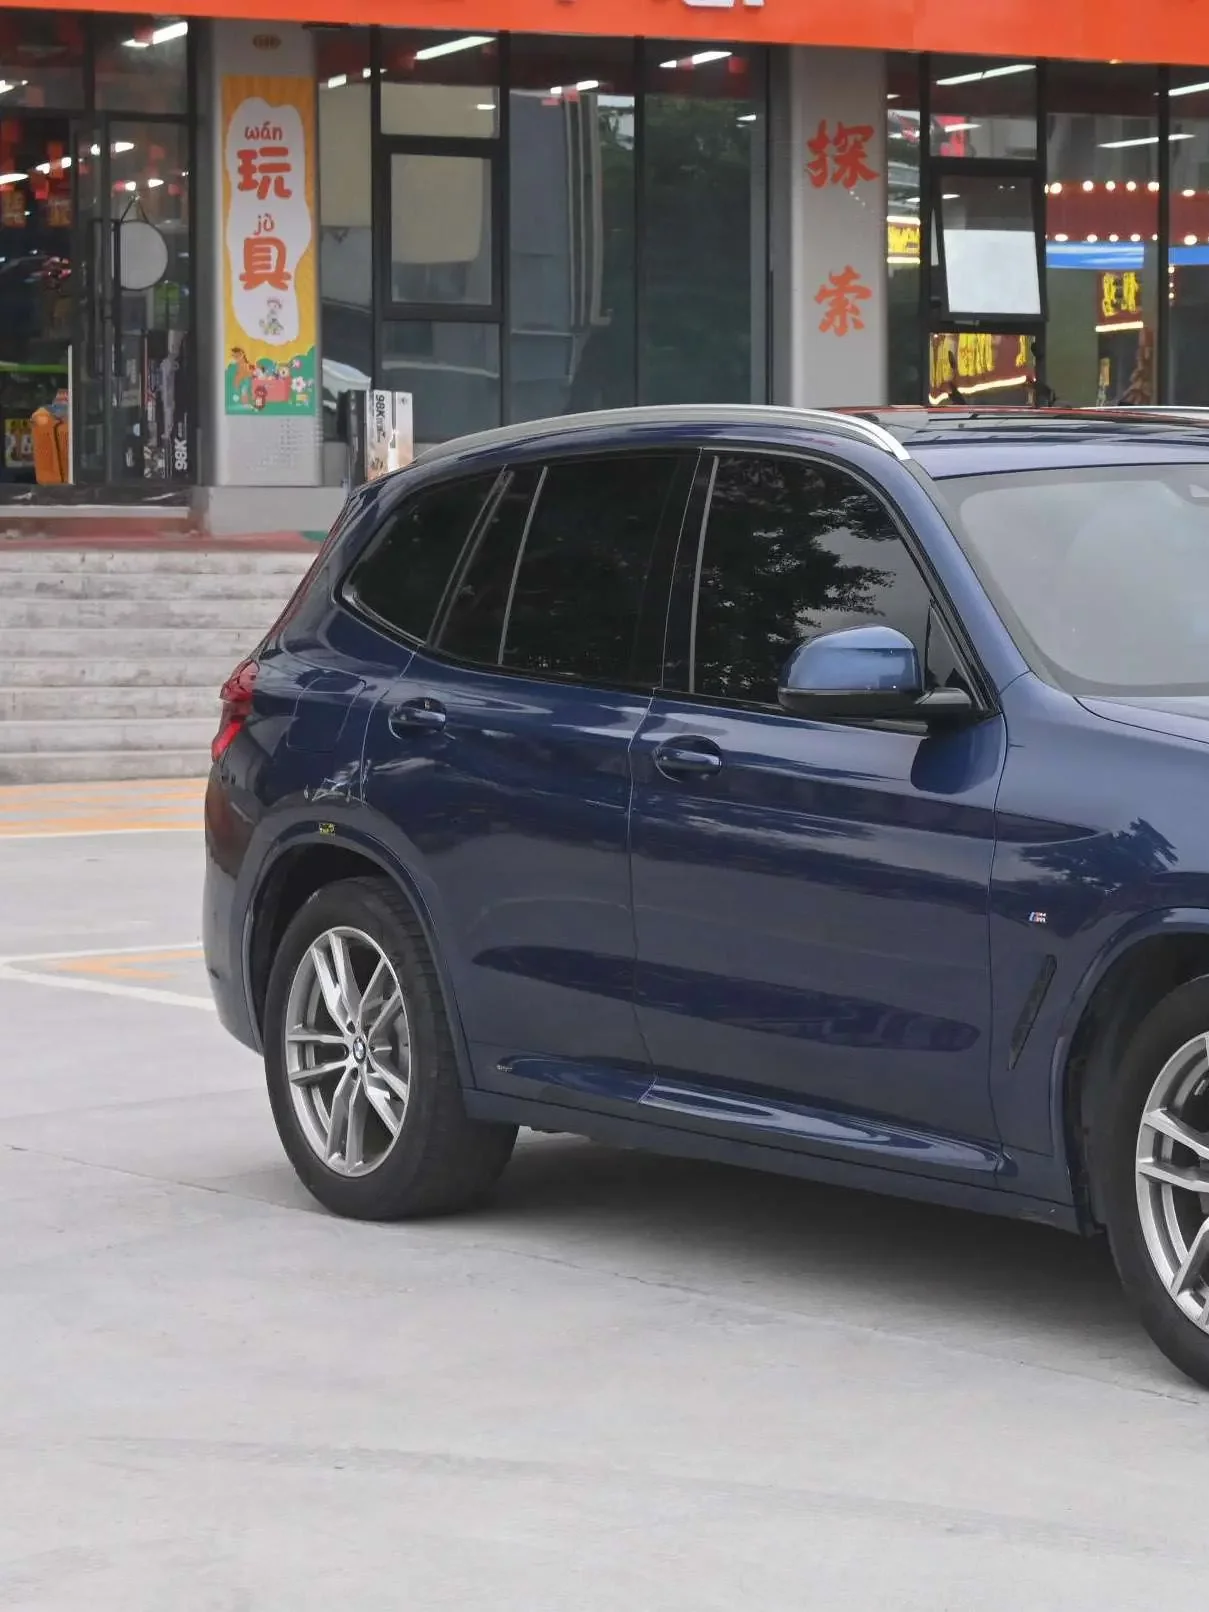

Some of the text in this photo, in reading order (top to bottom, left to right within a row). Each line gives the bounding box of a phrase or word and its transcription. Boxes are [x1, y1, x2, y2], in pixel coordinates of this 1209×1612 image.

[244, 121, 283, 141] wán
[805, 119, 881, 337] 探索
[174, 437, 187, 470] 98K
